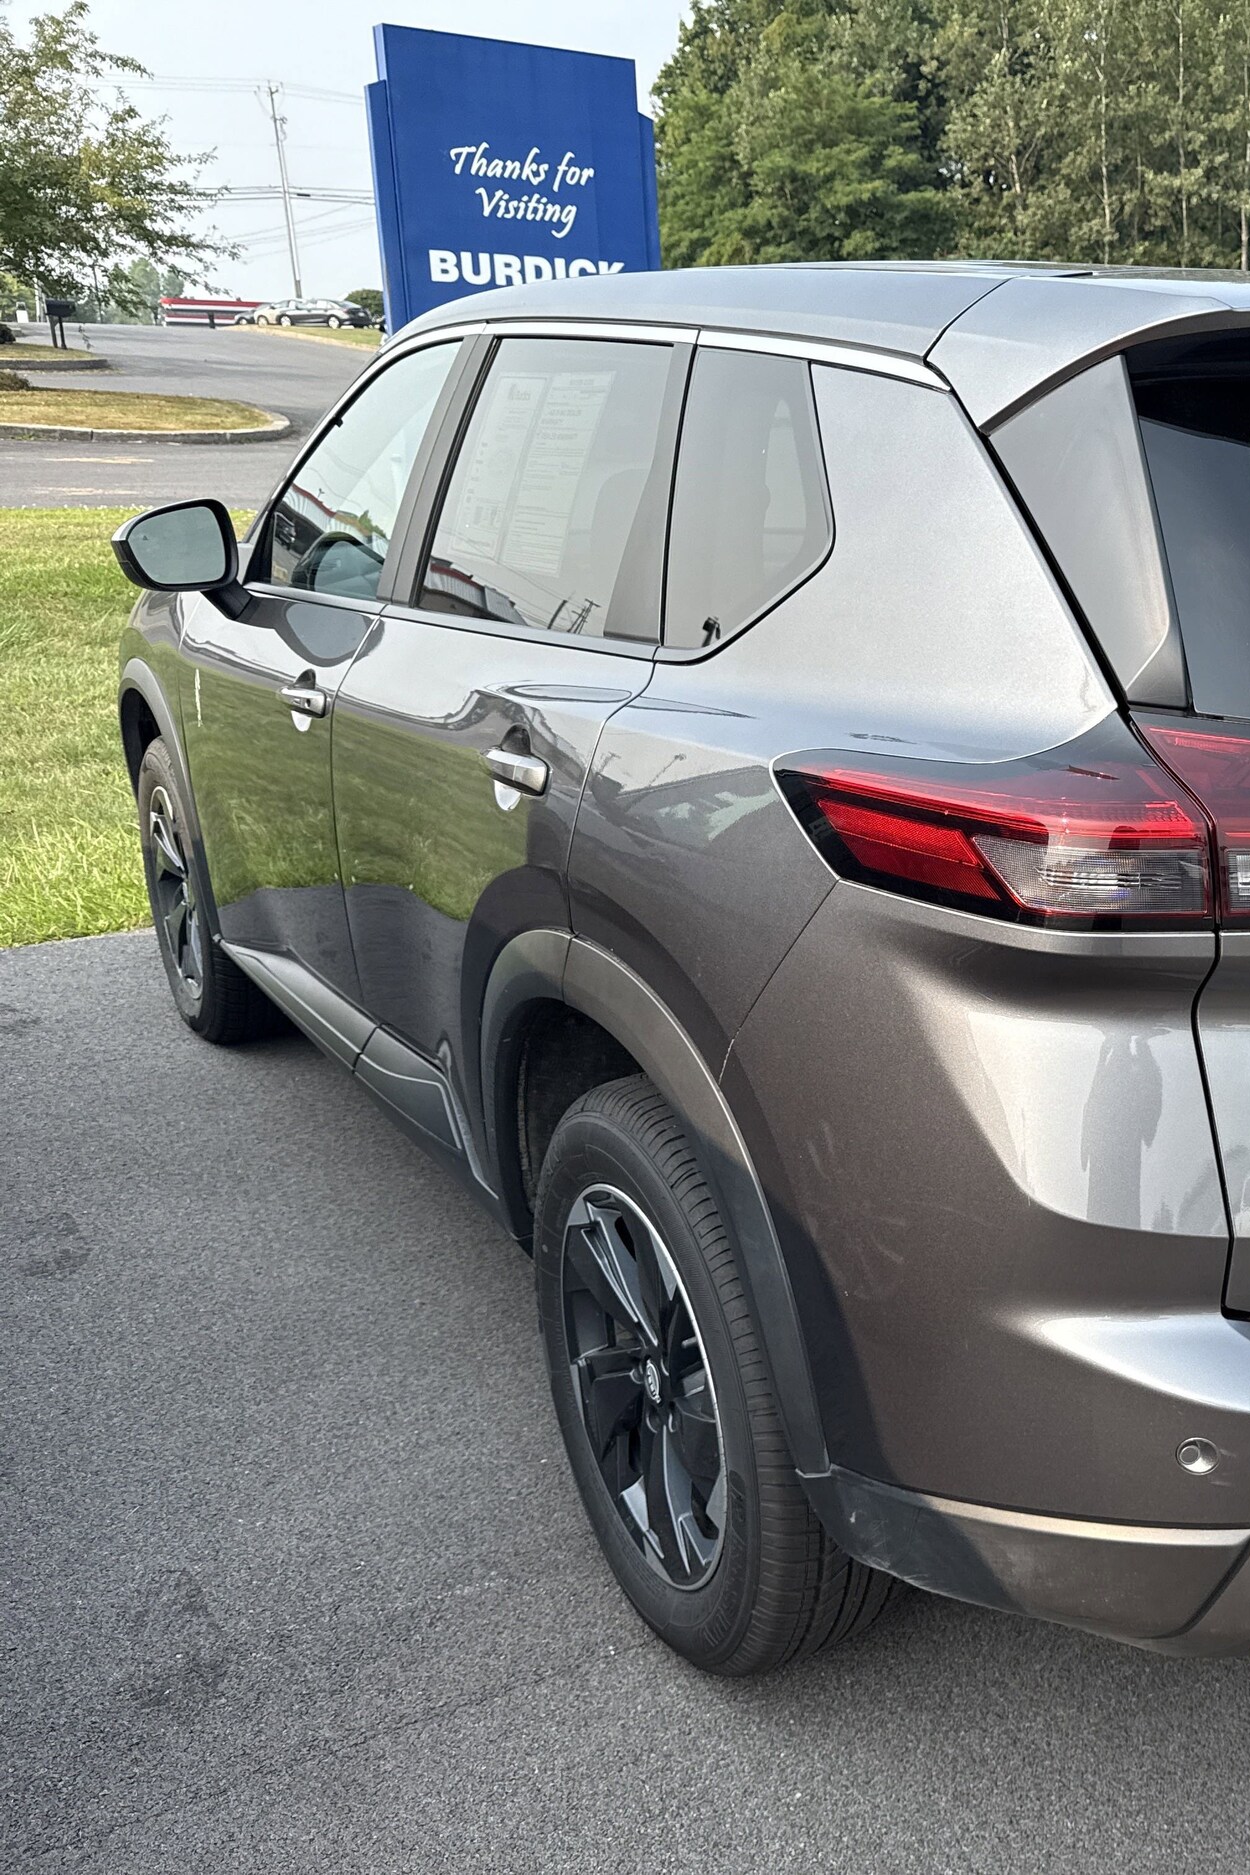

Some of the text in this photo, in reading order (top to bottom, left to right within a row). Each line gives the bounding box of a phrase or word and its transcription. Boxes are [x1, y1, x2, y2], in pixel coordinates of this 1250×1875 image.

[450, 142, 595, 193] Thanks for
[475, 187, 578, 239] Visiting
